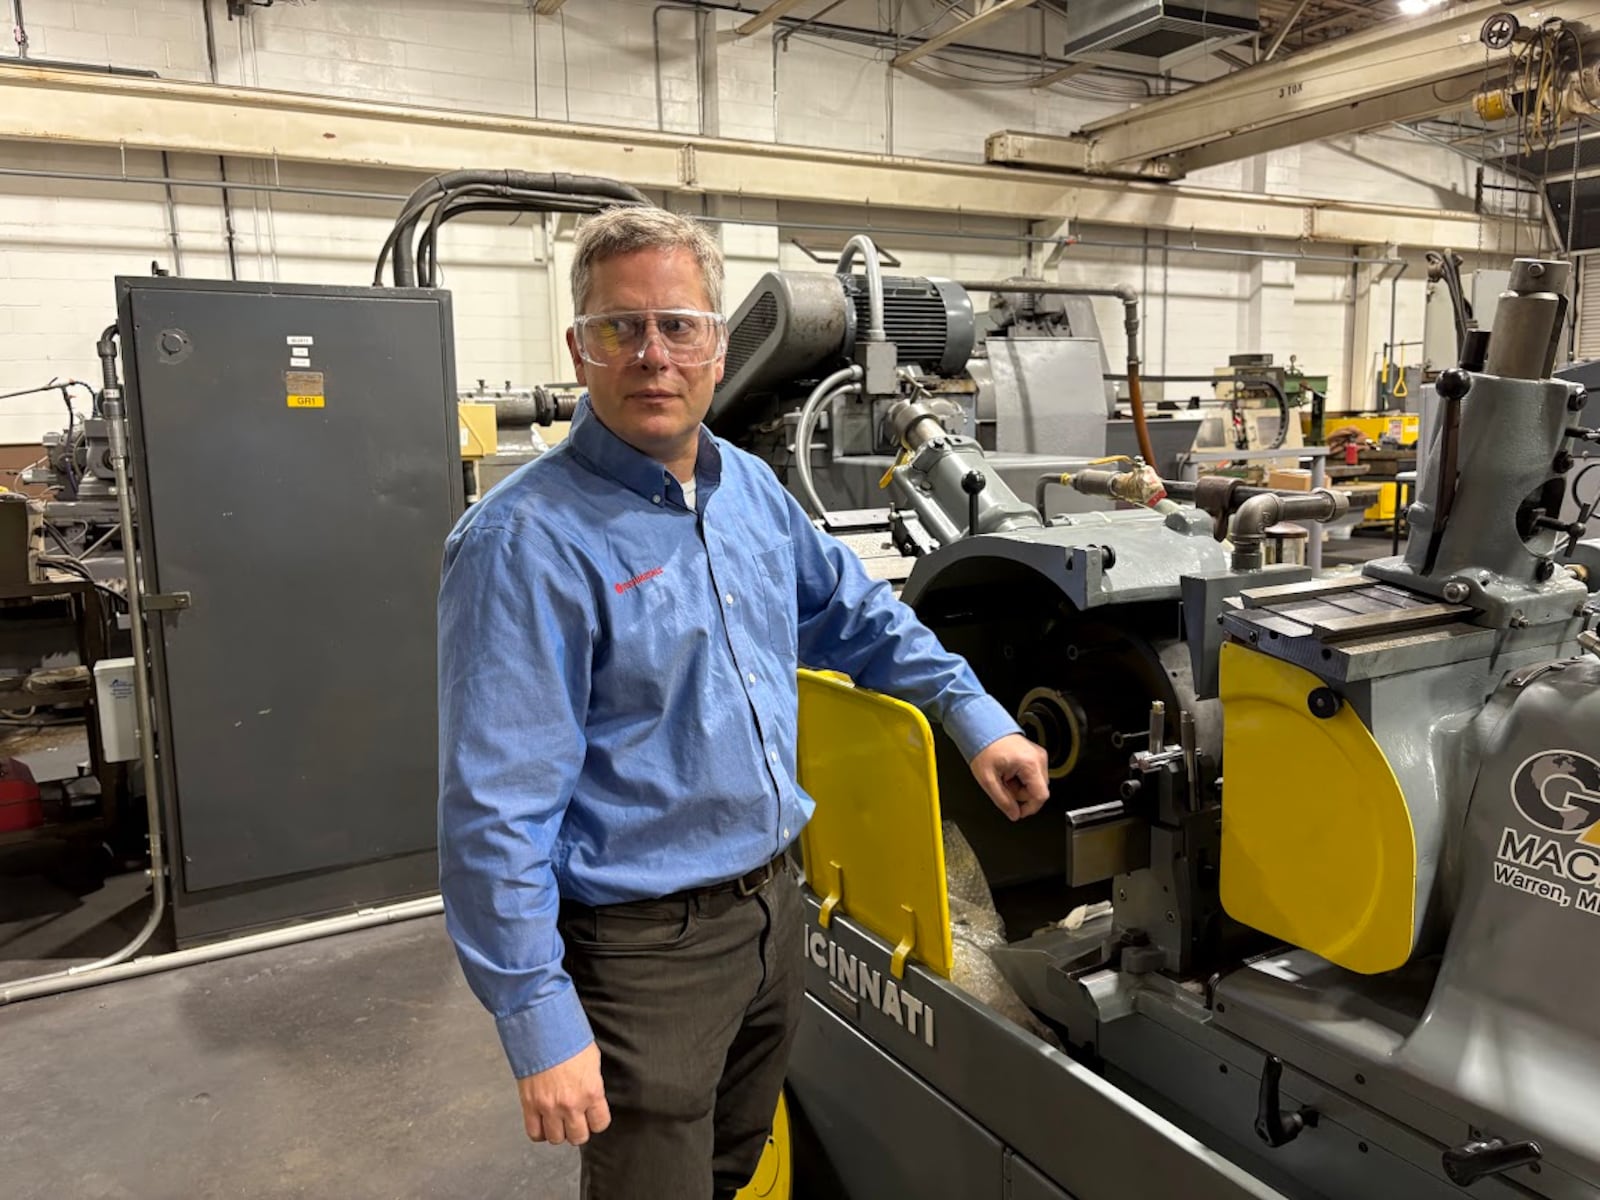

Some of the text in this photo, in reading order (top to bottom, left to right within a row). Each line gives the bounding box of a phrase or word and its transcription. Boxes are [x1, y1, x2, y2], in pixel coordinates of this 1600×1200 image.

[297, 397, 316, 405] GR1
[1494, 861, 1571, 907] Warren,
[1497, 827, 1600, 889] MAC
[804, 923, 934, 1048] CINNATI
